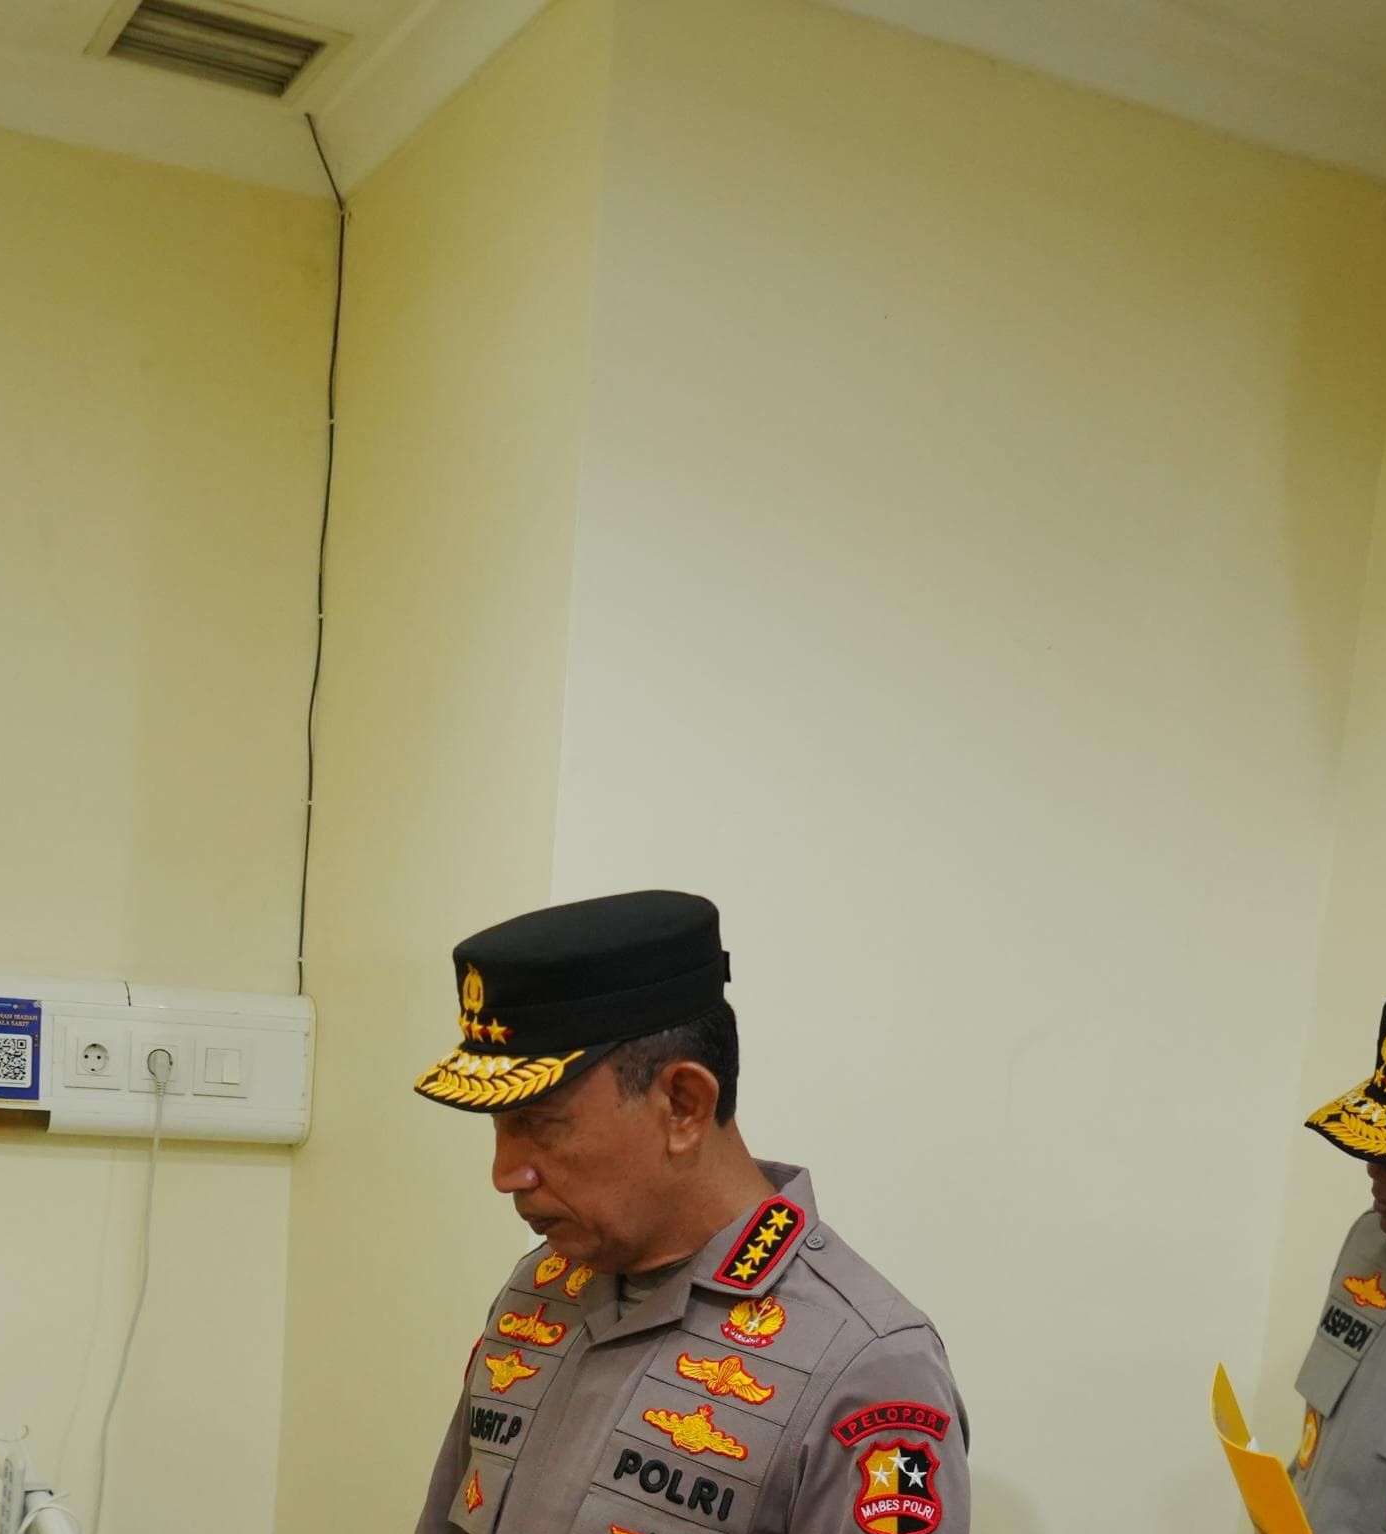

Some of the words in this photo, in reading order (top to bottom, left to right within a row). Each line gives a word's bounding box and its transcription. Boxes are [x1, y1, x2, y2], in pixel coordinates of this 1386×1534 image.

[1321, 1304, 1353, 1338] ASEP
[1344, 1320, 1373, 1352] EDI
[848, 1408, 937, 1435] PELOPOR
[614, 1448, 734, 1522] POLRI
[861, 1499, 900, 1520] MABES
[902, 1500, 935, 1519] POLRI
